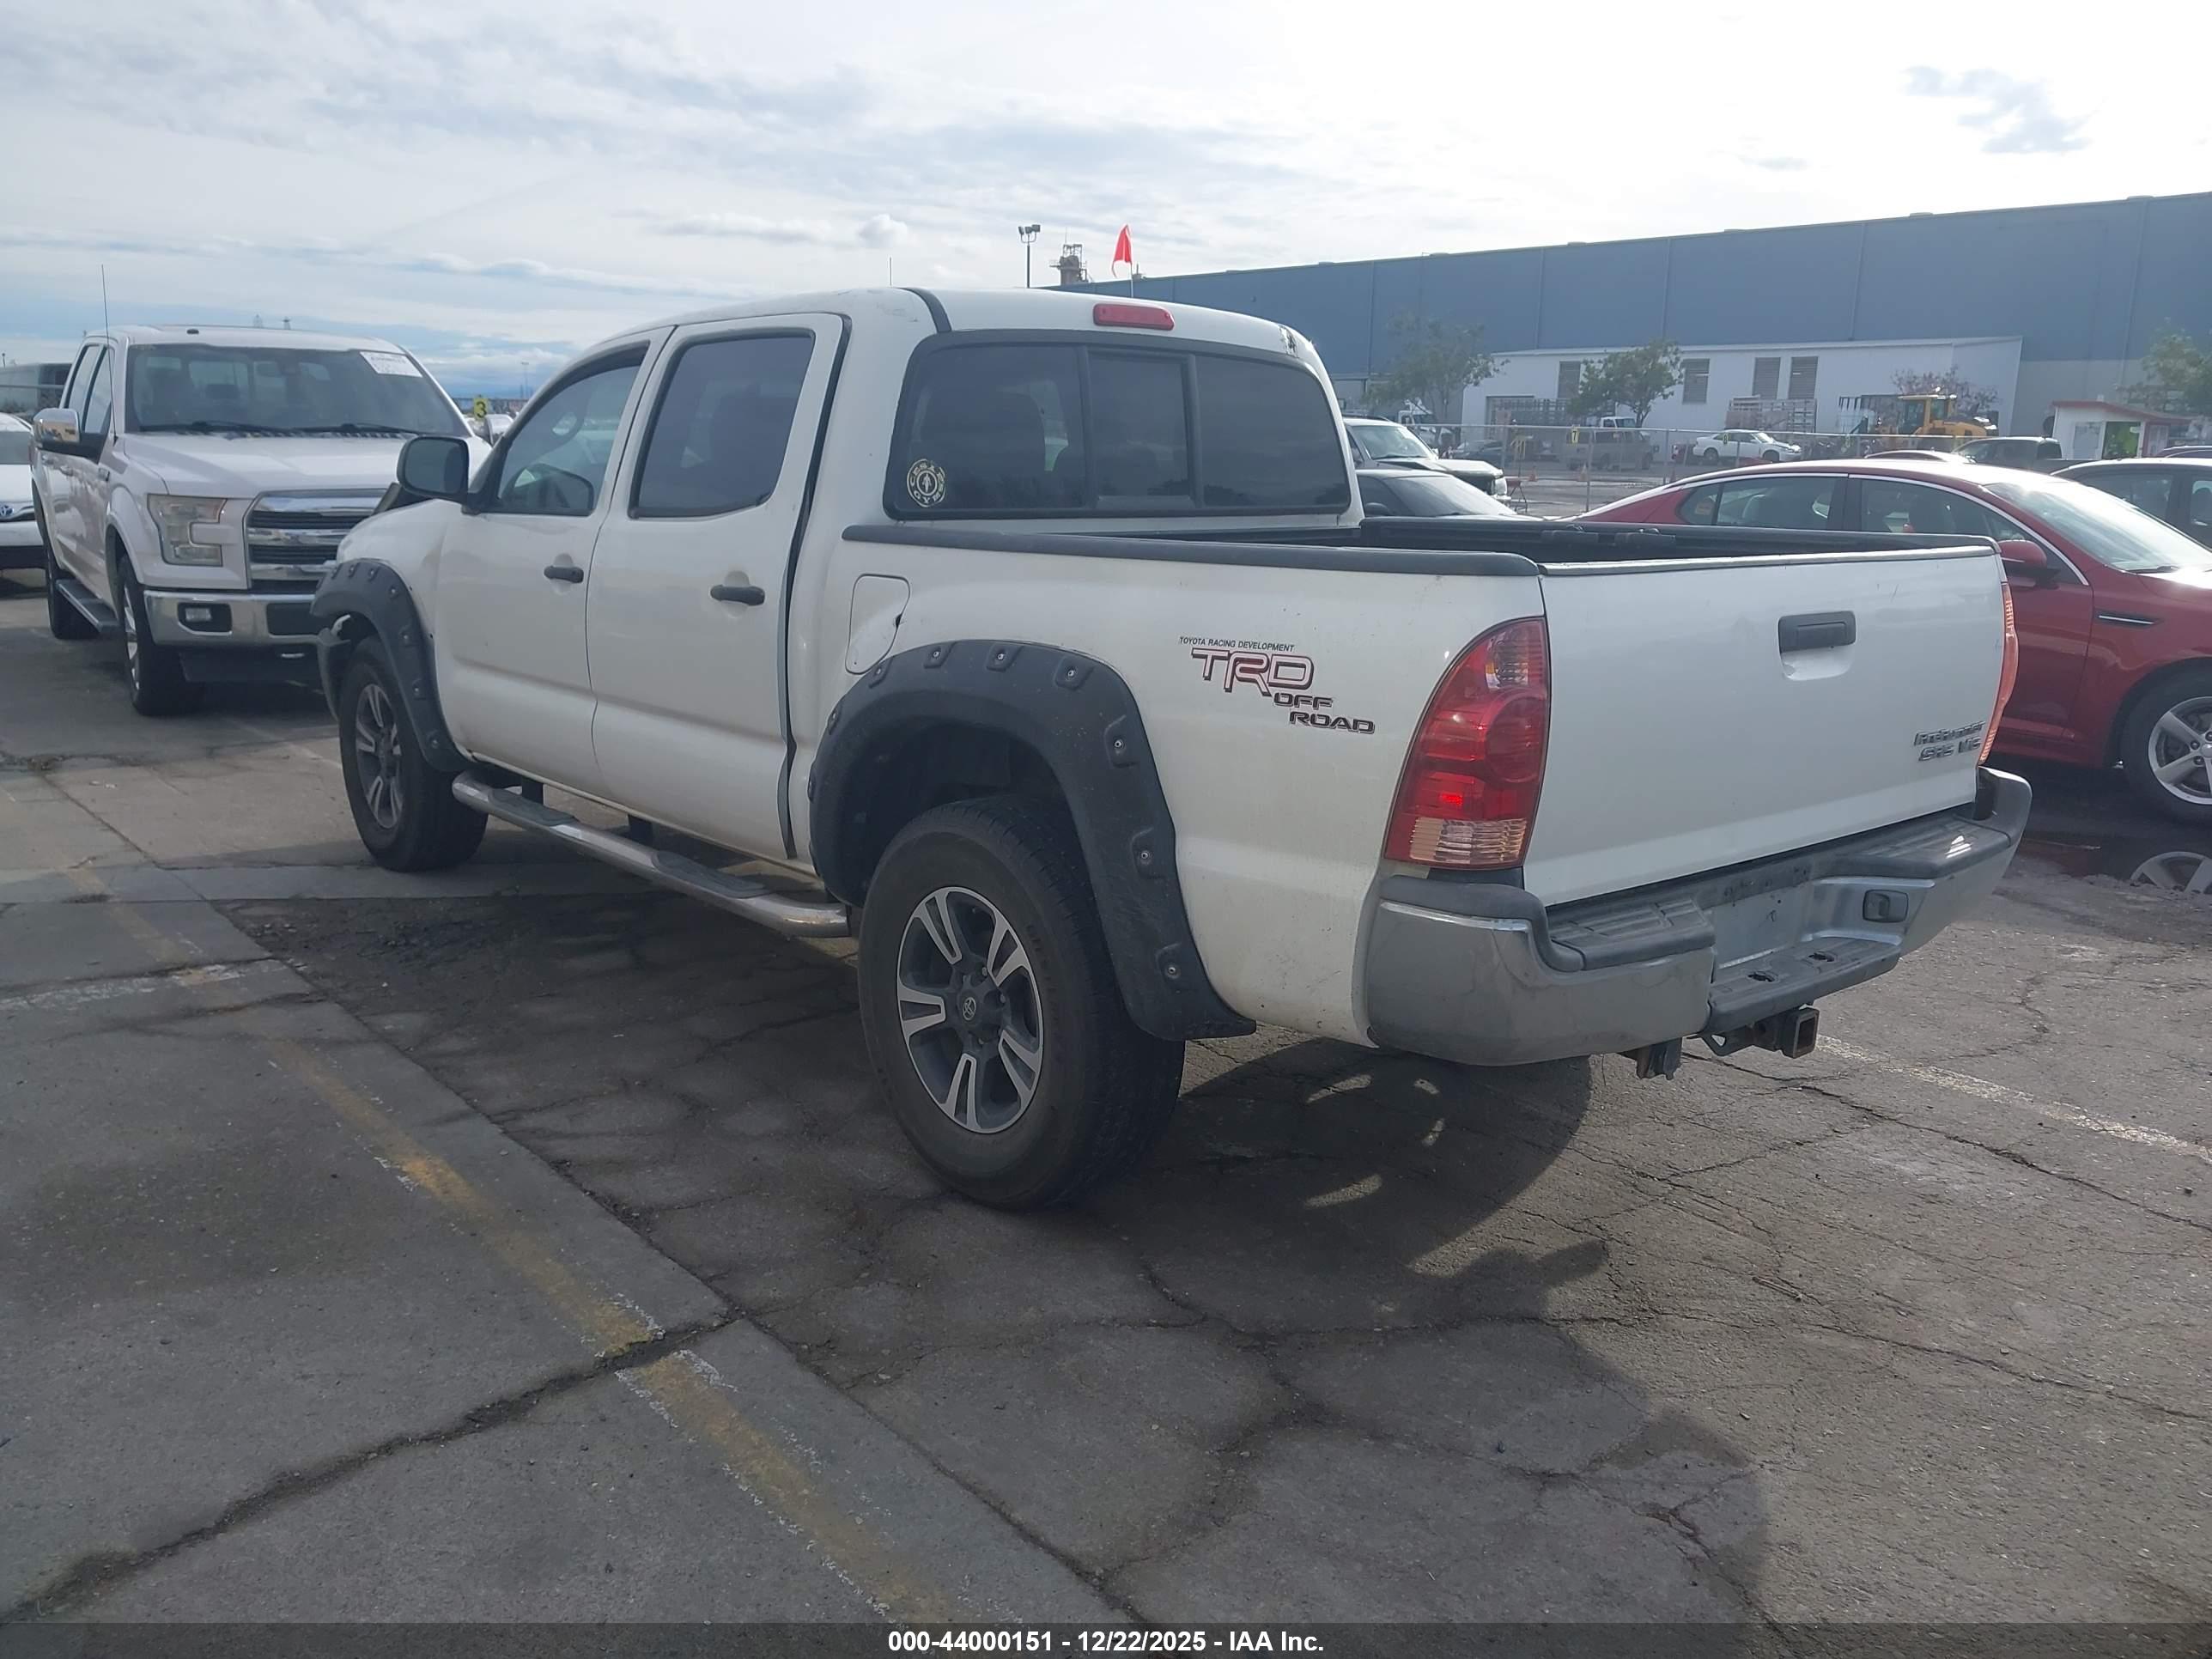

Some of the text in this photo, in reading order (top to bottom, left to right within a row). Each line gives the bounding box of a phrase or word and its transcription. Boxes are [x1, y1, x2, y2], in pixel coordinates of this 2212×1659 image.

[476, 401, 488, 418] 3
[1179, 636, 1295, 653] TOYOTA RACING DEVELOPMENT
[1191, 647, 1315, 697] TRD
[1273, 691, 1334, 710] OFF
[1289, 710, 1376, 734] ROAD
